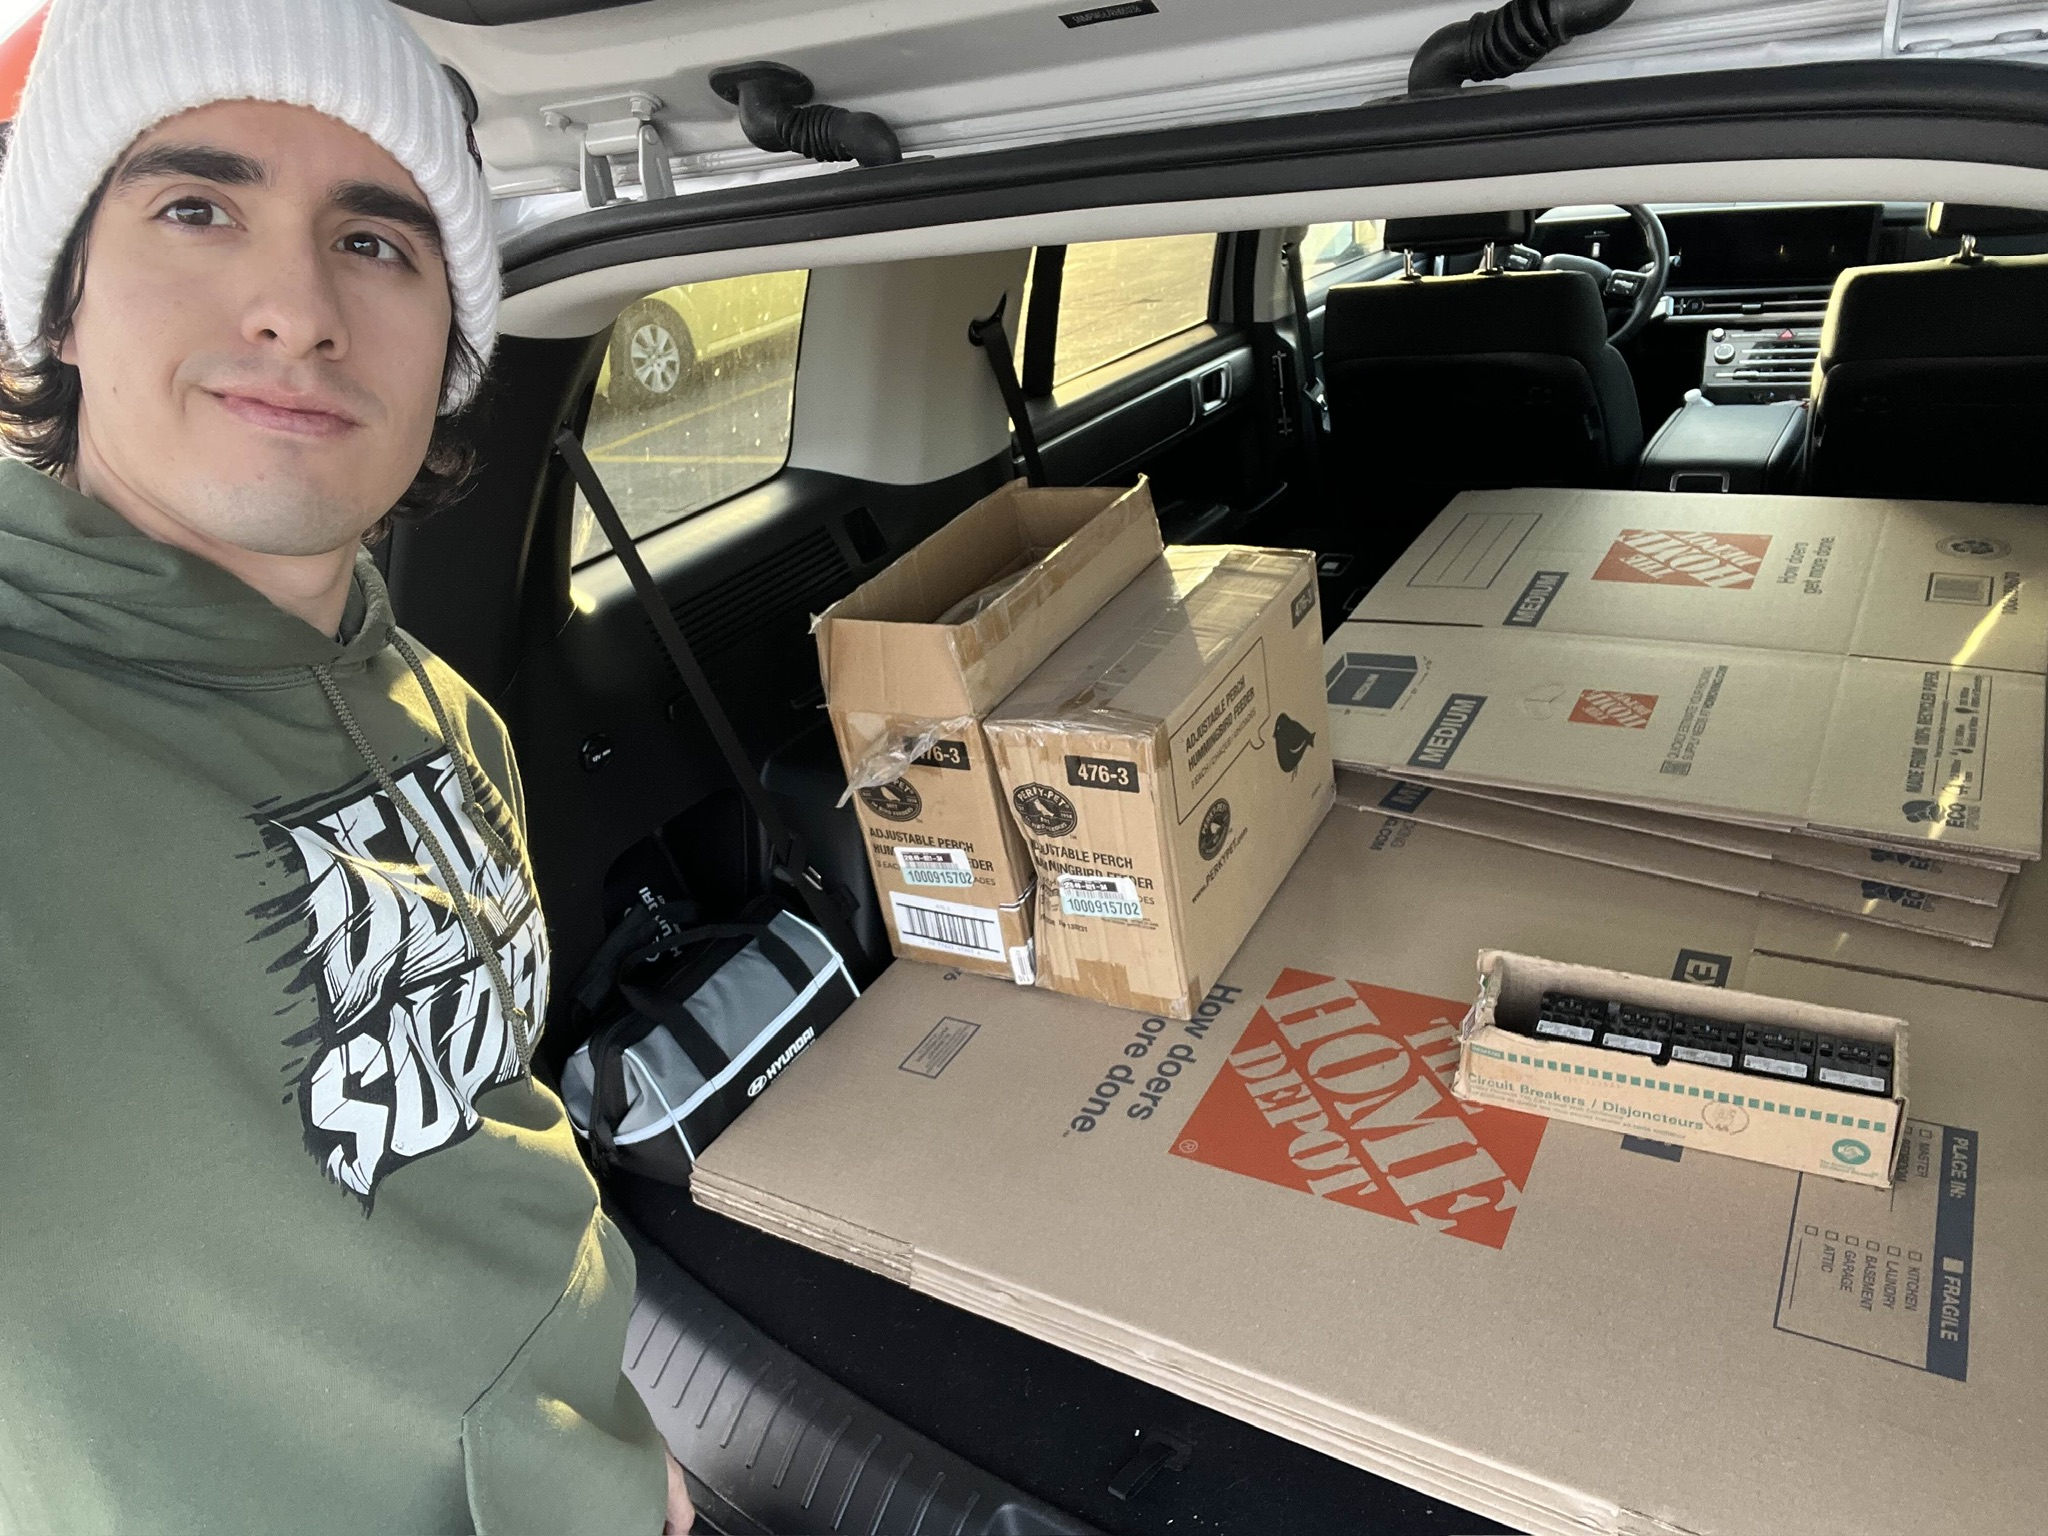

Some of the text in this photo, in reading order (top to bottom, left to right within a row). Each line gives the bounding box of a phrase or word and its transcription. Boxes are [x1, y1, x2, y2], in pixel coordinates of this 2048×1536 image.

[1616, 530, 1755, 588] HOME
[1776, 565, 1800, 584] How
[1512, 575, 1560, 623] MEDIUM
[1187, 698, 1226, 753] ADJUSTABLE
[1418, 698, 1477, 764] MEDIUM
[1077, 763, 1130, 786] 476-3
[1946, 802, 1967, 828] ECO
[870, 828, 974, 853] ADJUSTABLE PERCH
[1093, 853, 1133, 870] PERCH
[908, 869, 973, 885] 1000915702
[1068, 898, 1141, 916] 1000915702
[766, 1026, 815, 1080] HYUNDAI
[1070, 1017, 1167, 1132] ore done
[1126, 984, 1243, 1120] How doers
[1228, 1040, 1377, 1197] DEPOT
[1262, 980, 1522, 1234] HOME
[1468, 1072, 1514, 1093] Circuit
[1520, 1083, 1585, 1107] Breakers
[1602, 1101, 1704, 1131] Disjoncteurs
[1916, 1141, 1933, 1179] MASTER
[1949, 1136, 1969, 1199] PLACE IN:
[1820, 1243, 1836, 1274] ATTIC
[1840, 1249, 1857, 1294] GARAGE
[1860, 1254, 1878, 1312] BASEMENT
[1883, 1260, 1900, 1310] LAUNDRY
[1905, 1265, 1921, 1312] KITCHEN
[1939, 1275, 1961, 1342] FRAGILE
